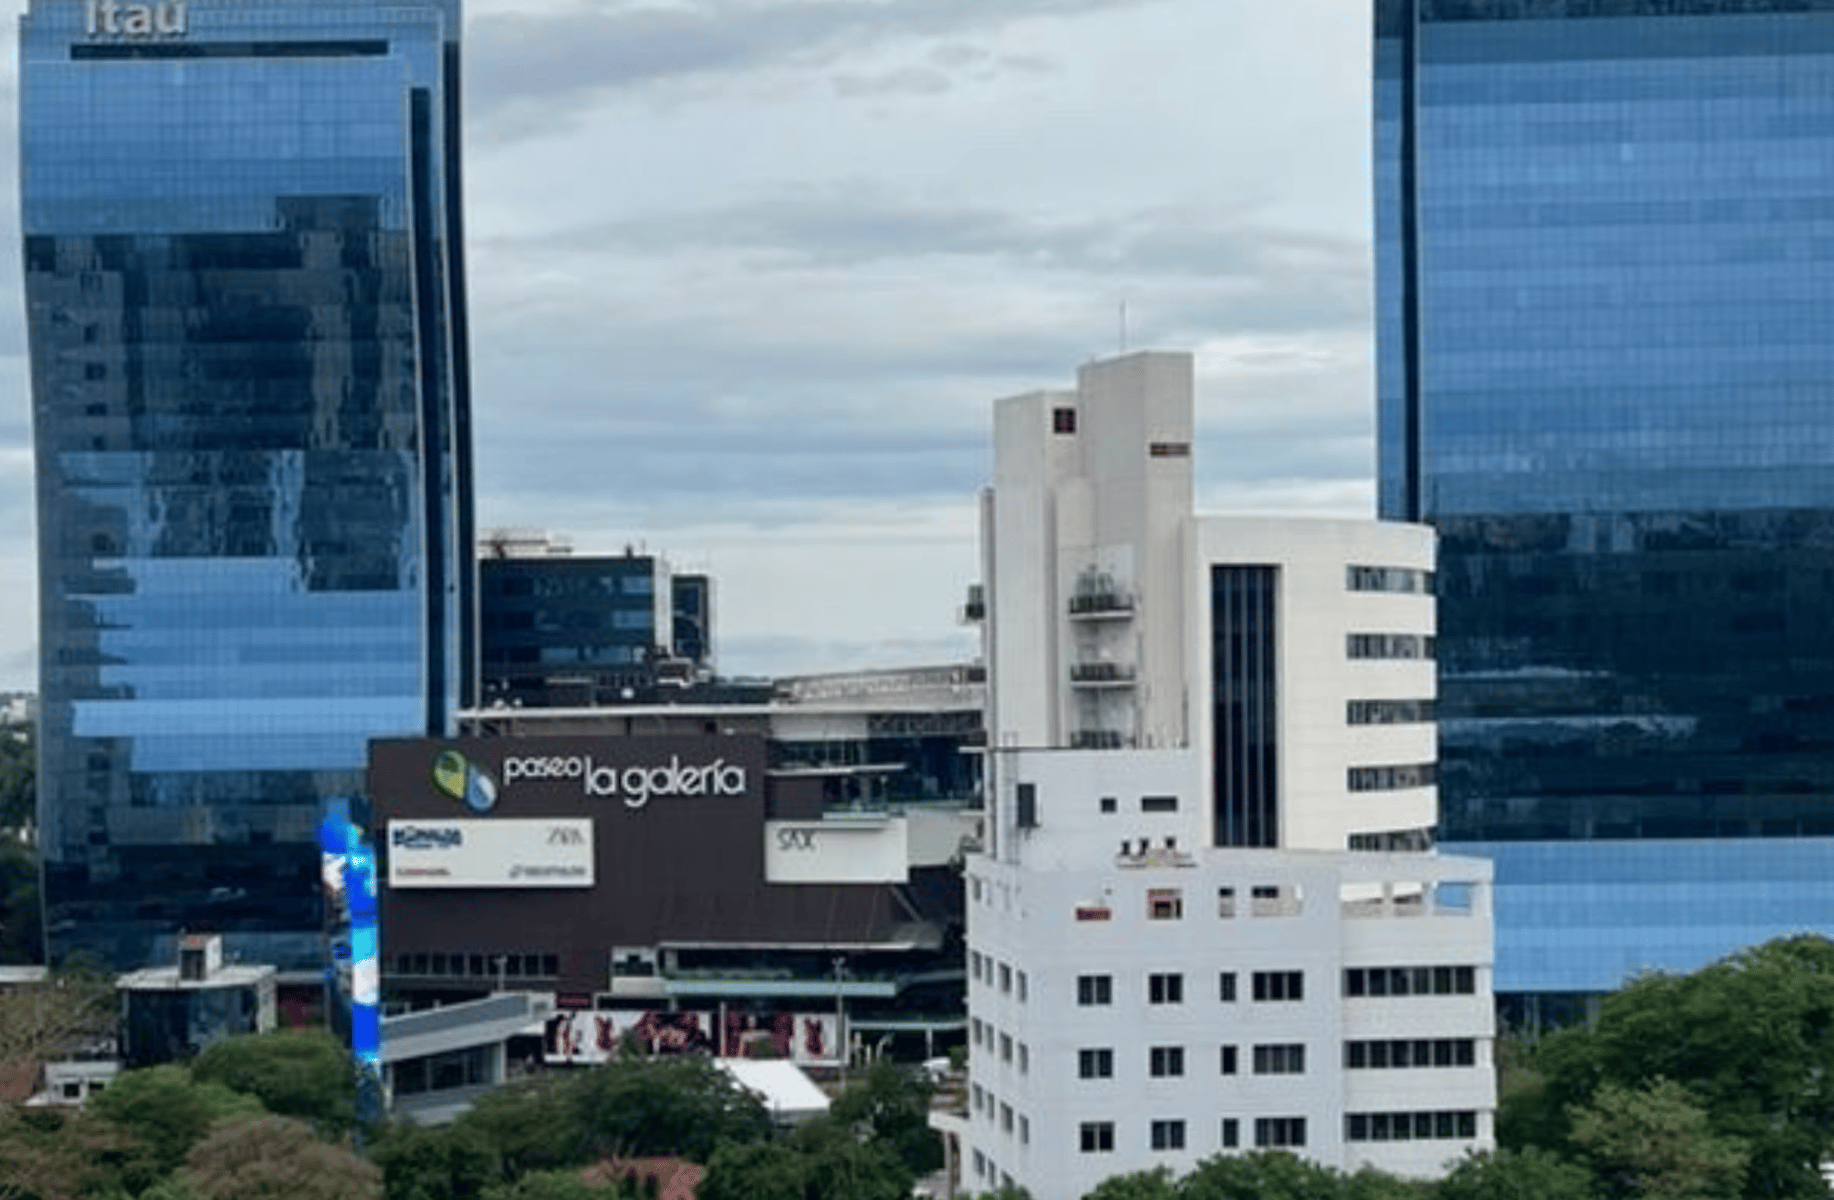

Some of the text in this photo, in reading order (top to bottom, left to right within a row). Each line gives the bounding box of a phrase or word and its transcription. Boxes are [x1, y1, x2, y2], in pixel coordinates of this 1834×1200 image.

[503, 754, 747, 808] paseo la galería
